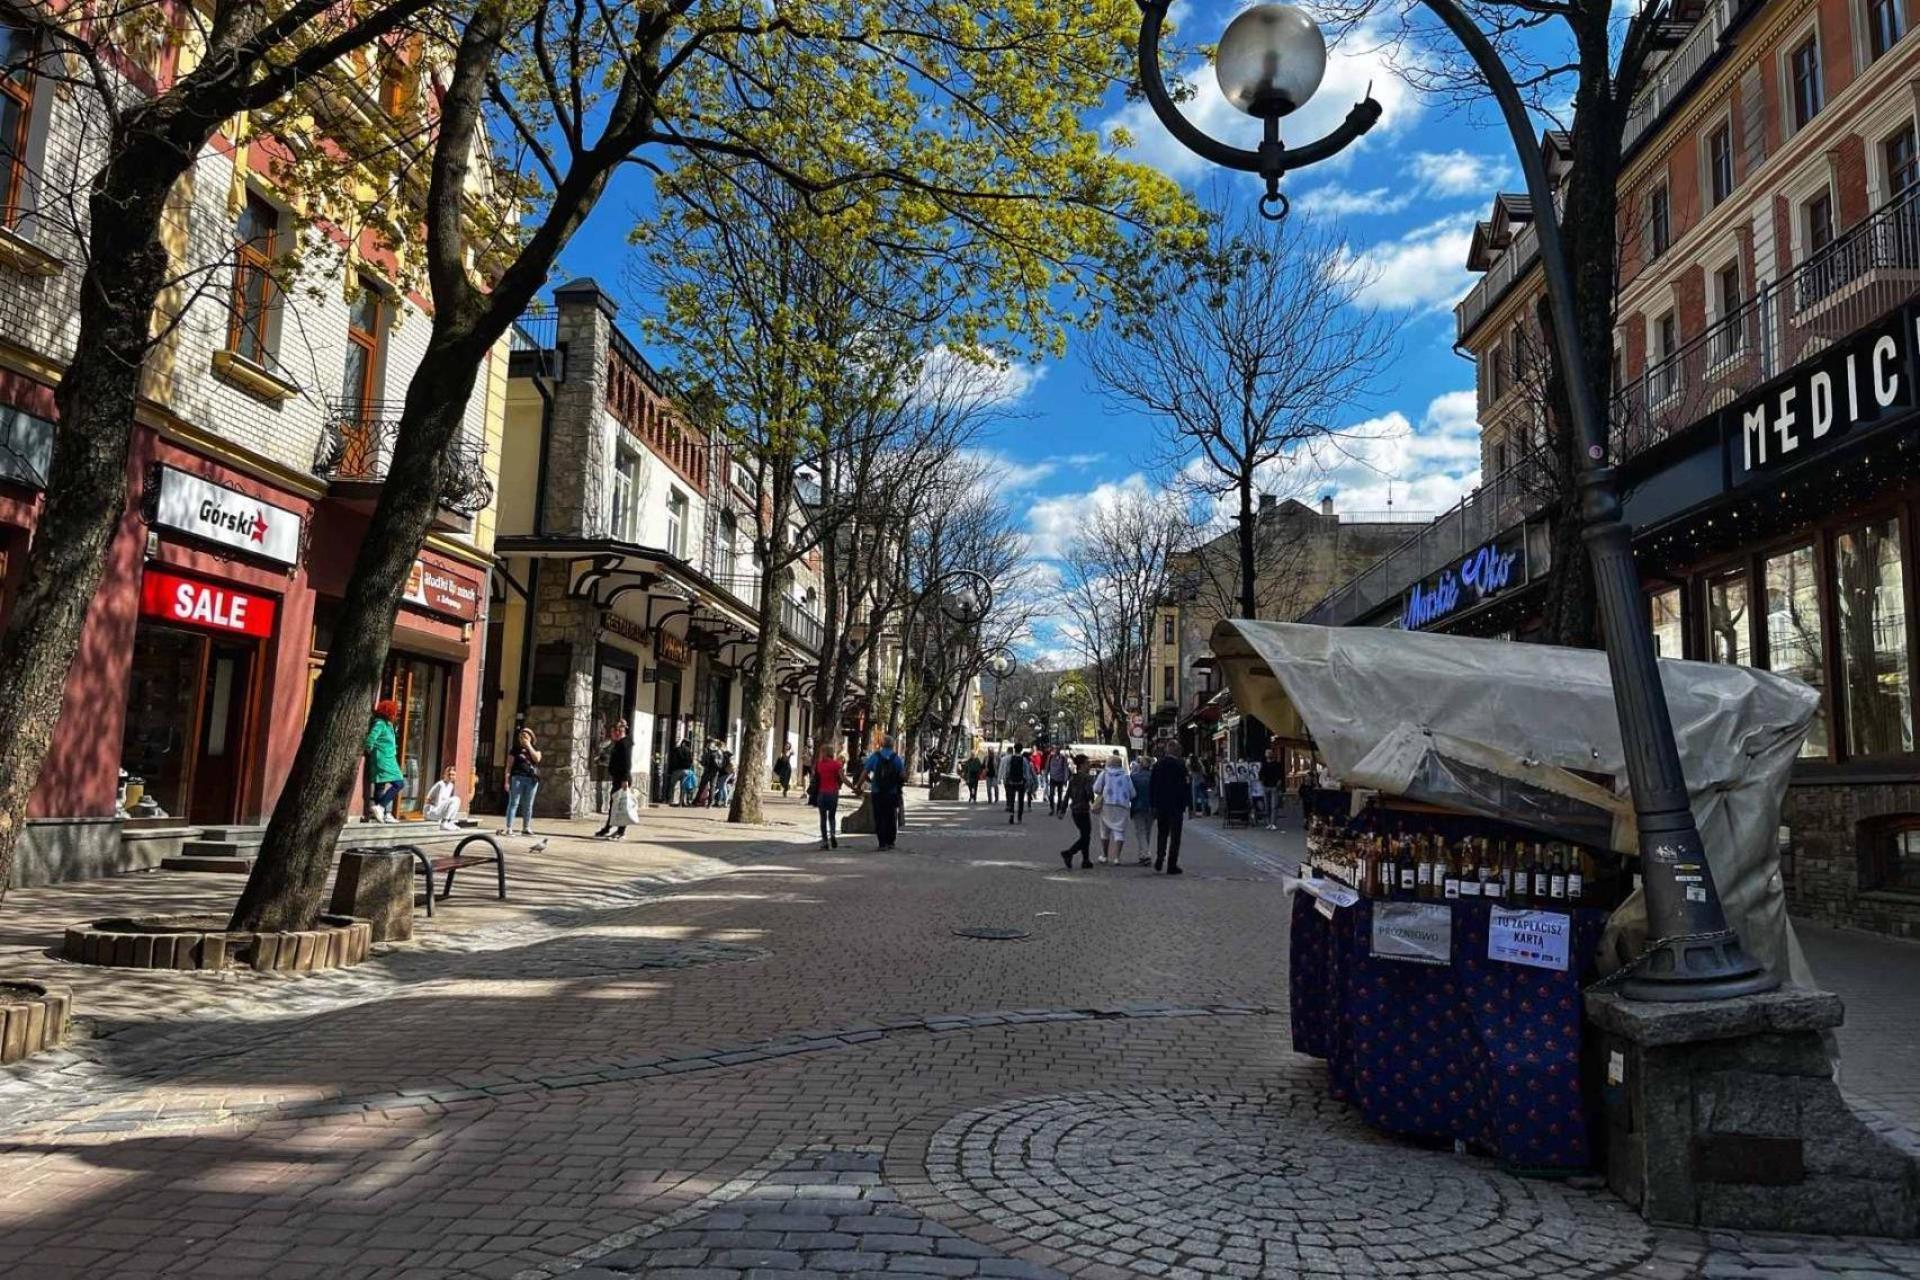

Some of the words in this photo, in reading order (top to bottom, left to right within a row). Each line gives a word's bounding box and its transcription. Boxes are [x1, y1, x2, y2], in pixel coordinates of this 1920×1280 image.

[1743, 317, 1920, 471] MEDIC
[199, 499, 254, 536] Górski
[1461, 545, 1516, 597] Oko
[174, 583, 248, 629] SALE
[1497, 916, 1509, 928] TU
